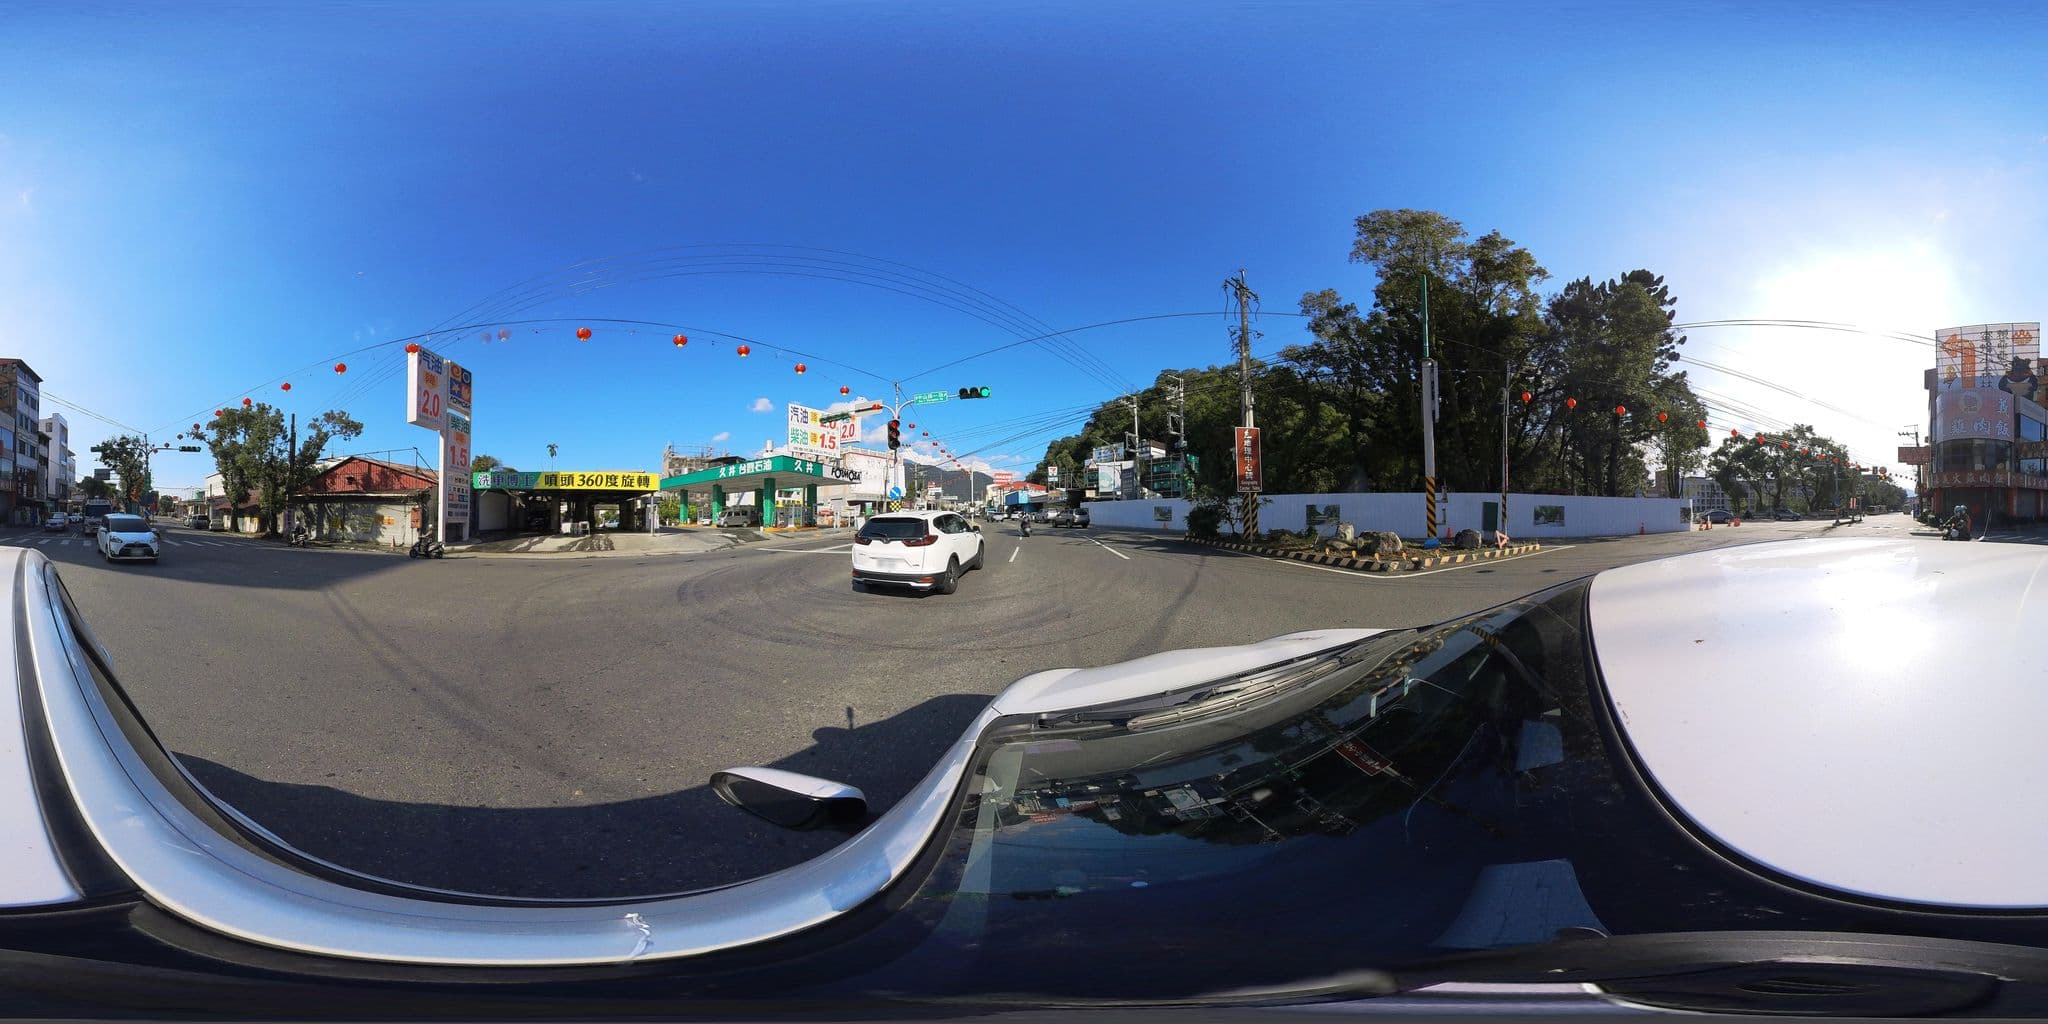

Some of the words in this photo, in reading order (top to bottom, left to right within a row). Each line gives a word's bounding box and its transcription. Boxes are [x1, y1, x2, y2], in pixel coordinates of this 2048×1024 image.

[422, 389, 440, 418] 2.0
[790, 405, 808, 425] 汽油
[790, 427, 808, 446] 柴油
[819, 433, 836, 450] 1.5
[841, 423, 855, 439] 2.0
[450, 445, 468, 467] 1.5
[719, 466, 736, 478] 久井
[794, 460, 814, 474] 久井
[831, 467, 861, 482] FORMOSA
[478, 474, 533, 487] 洗車博士
[544, 473, 650, 488] 噴頭360度旋轉
